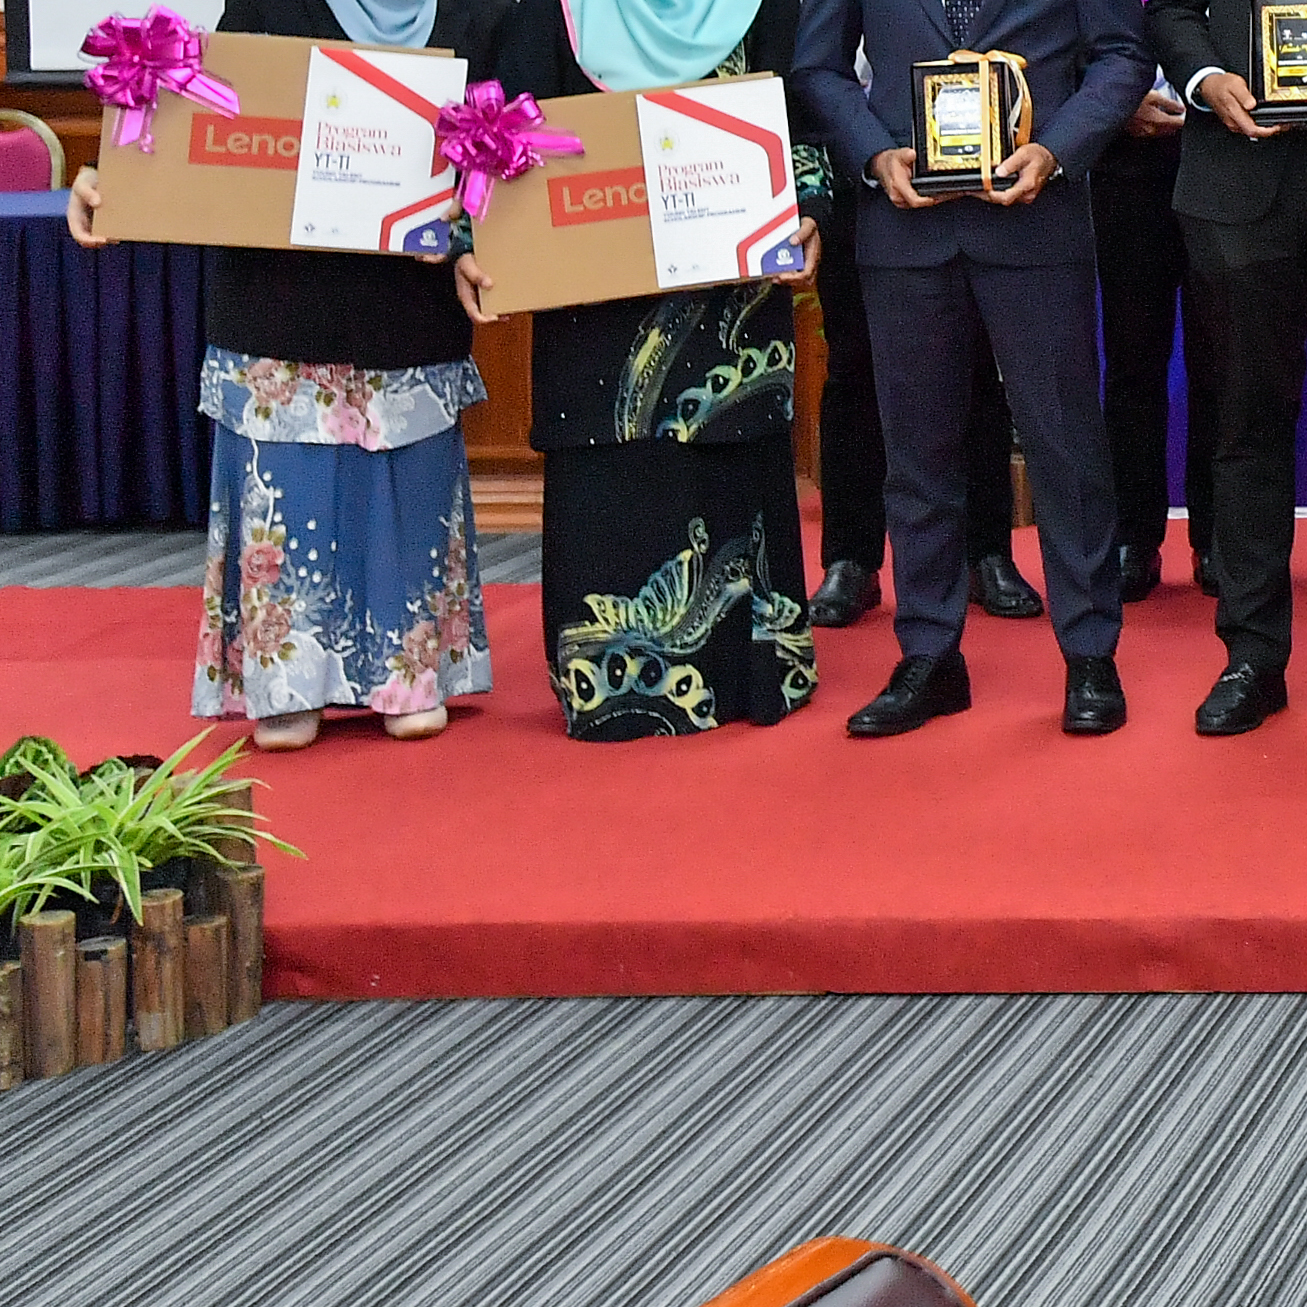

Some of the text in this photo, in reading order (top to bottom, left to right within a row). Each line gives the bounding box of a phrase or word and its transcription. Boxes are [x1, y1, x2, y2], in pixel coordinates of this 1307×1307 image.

[317, 121, 387, 139] Program
[204, 125, 299, 157] Leno
[316, 136, 401, 156] Biasiswa
[315, 153, 350, 170] YT-TI
[658, 161, 724, 176] Program
[660, 173, 740, 192] Biasiswa
[661, 192, 695, 210] YT-TI
